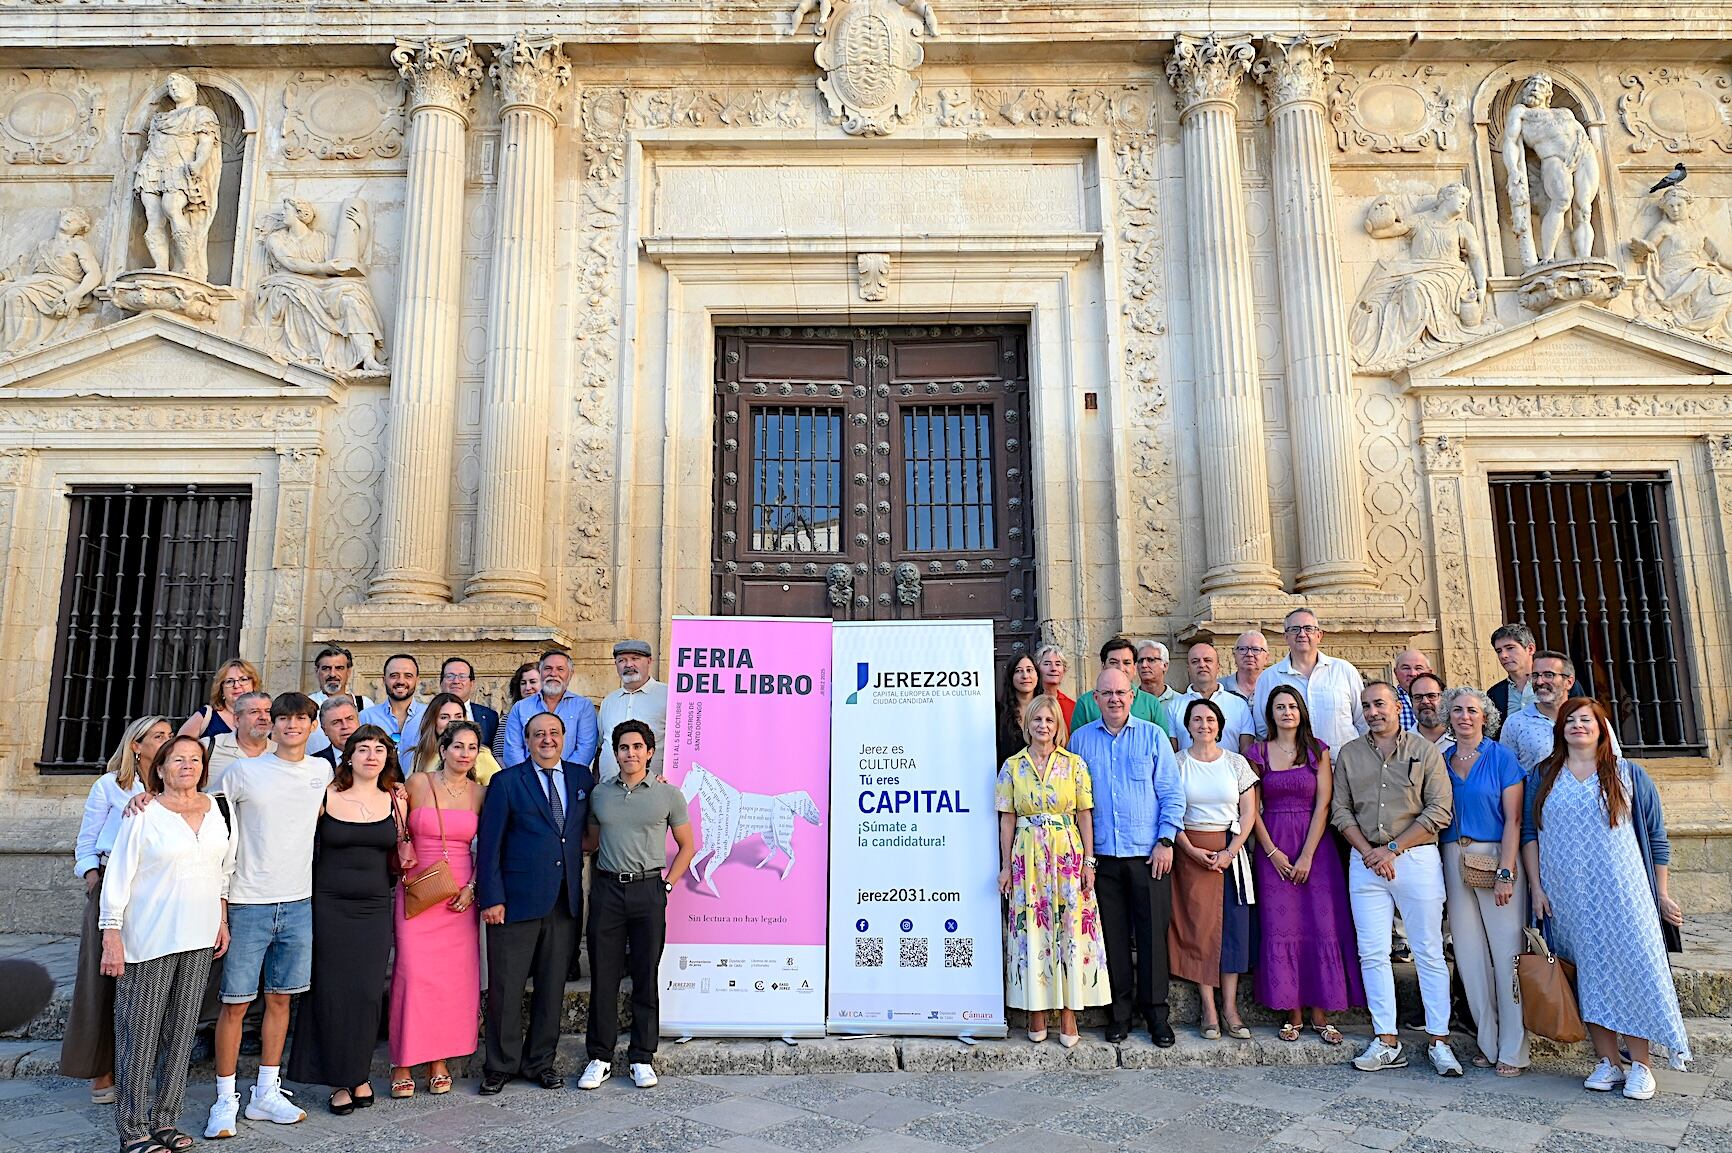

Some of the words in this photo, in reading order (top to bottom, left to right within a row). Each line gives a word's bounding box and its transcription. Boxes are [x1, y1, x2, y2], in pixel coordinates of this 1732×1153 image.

[678, 648, 754, 668] FERIA
[676, 673, 725, 694] DEL
[735, 674, 812, 695] LIBRO
[874, 671, 978, 688] JEREZ2031
[859, 744, 888, 754] Jerez
[892, 746, 904, 754] es
[859, 759, 916, 770] CULTURA
[859, 774, 872, 785] Tú
[876, 776, 900, 785] eres
[858, 790, 970, 814] CAPITAL
[858, 821, 907, 834] ¡Súmate
[911, 823, 918, 832] a
[858, 836, 868, 846] la
[872, 835, 946, 846] candidatura!
[857, 888, 960, 904] jerez2031.com
[745, 915, 758, 924] hay
[761, 915, 787, 925] legado
